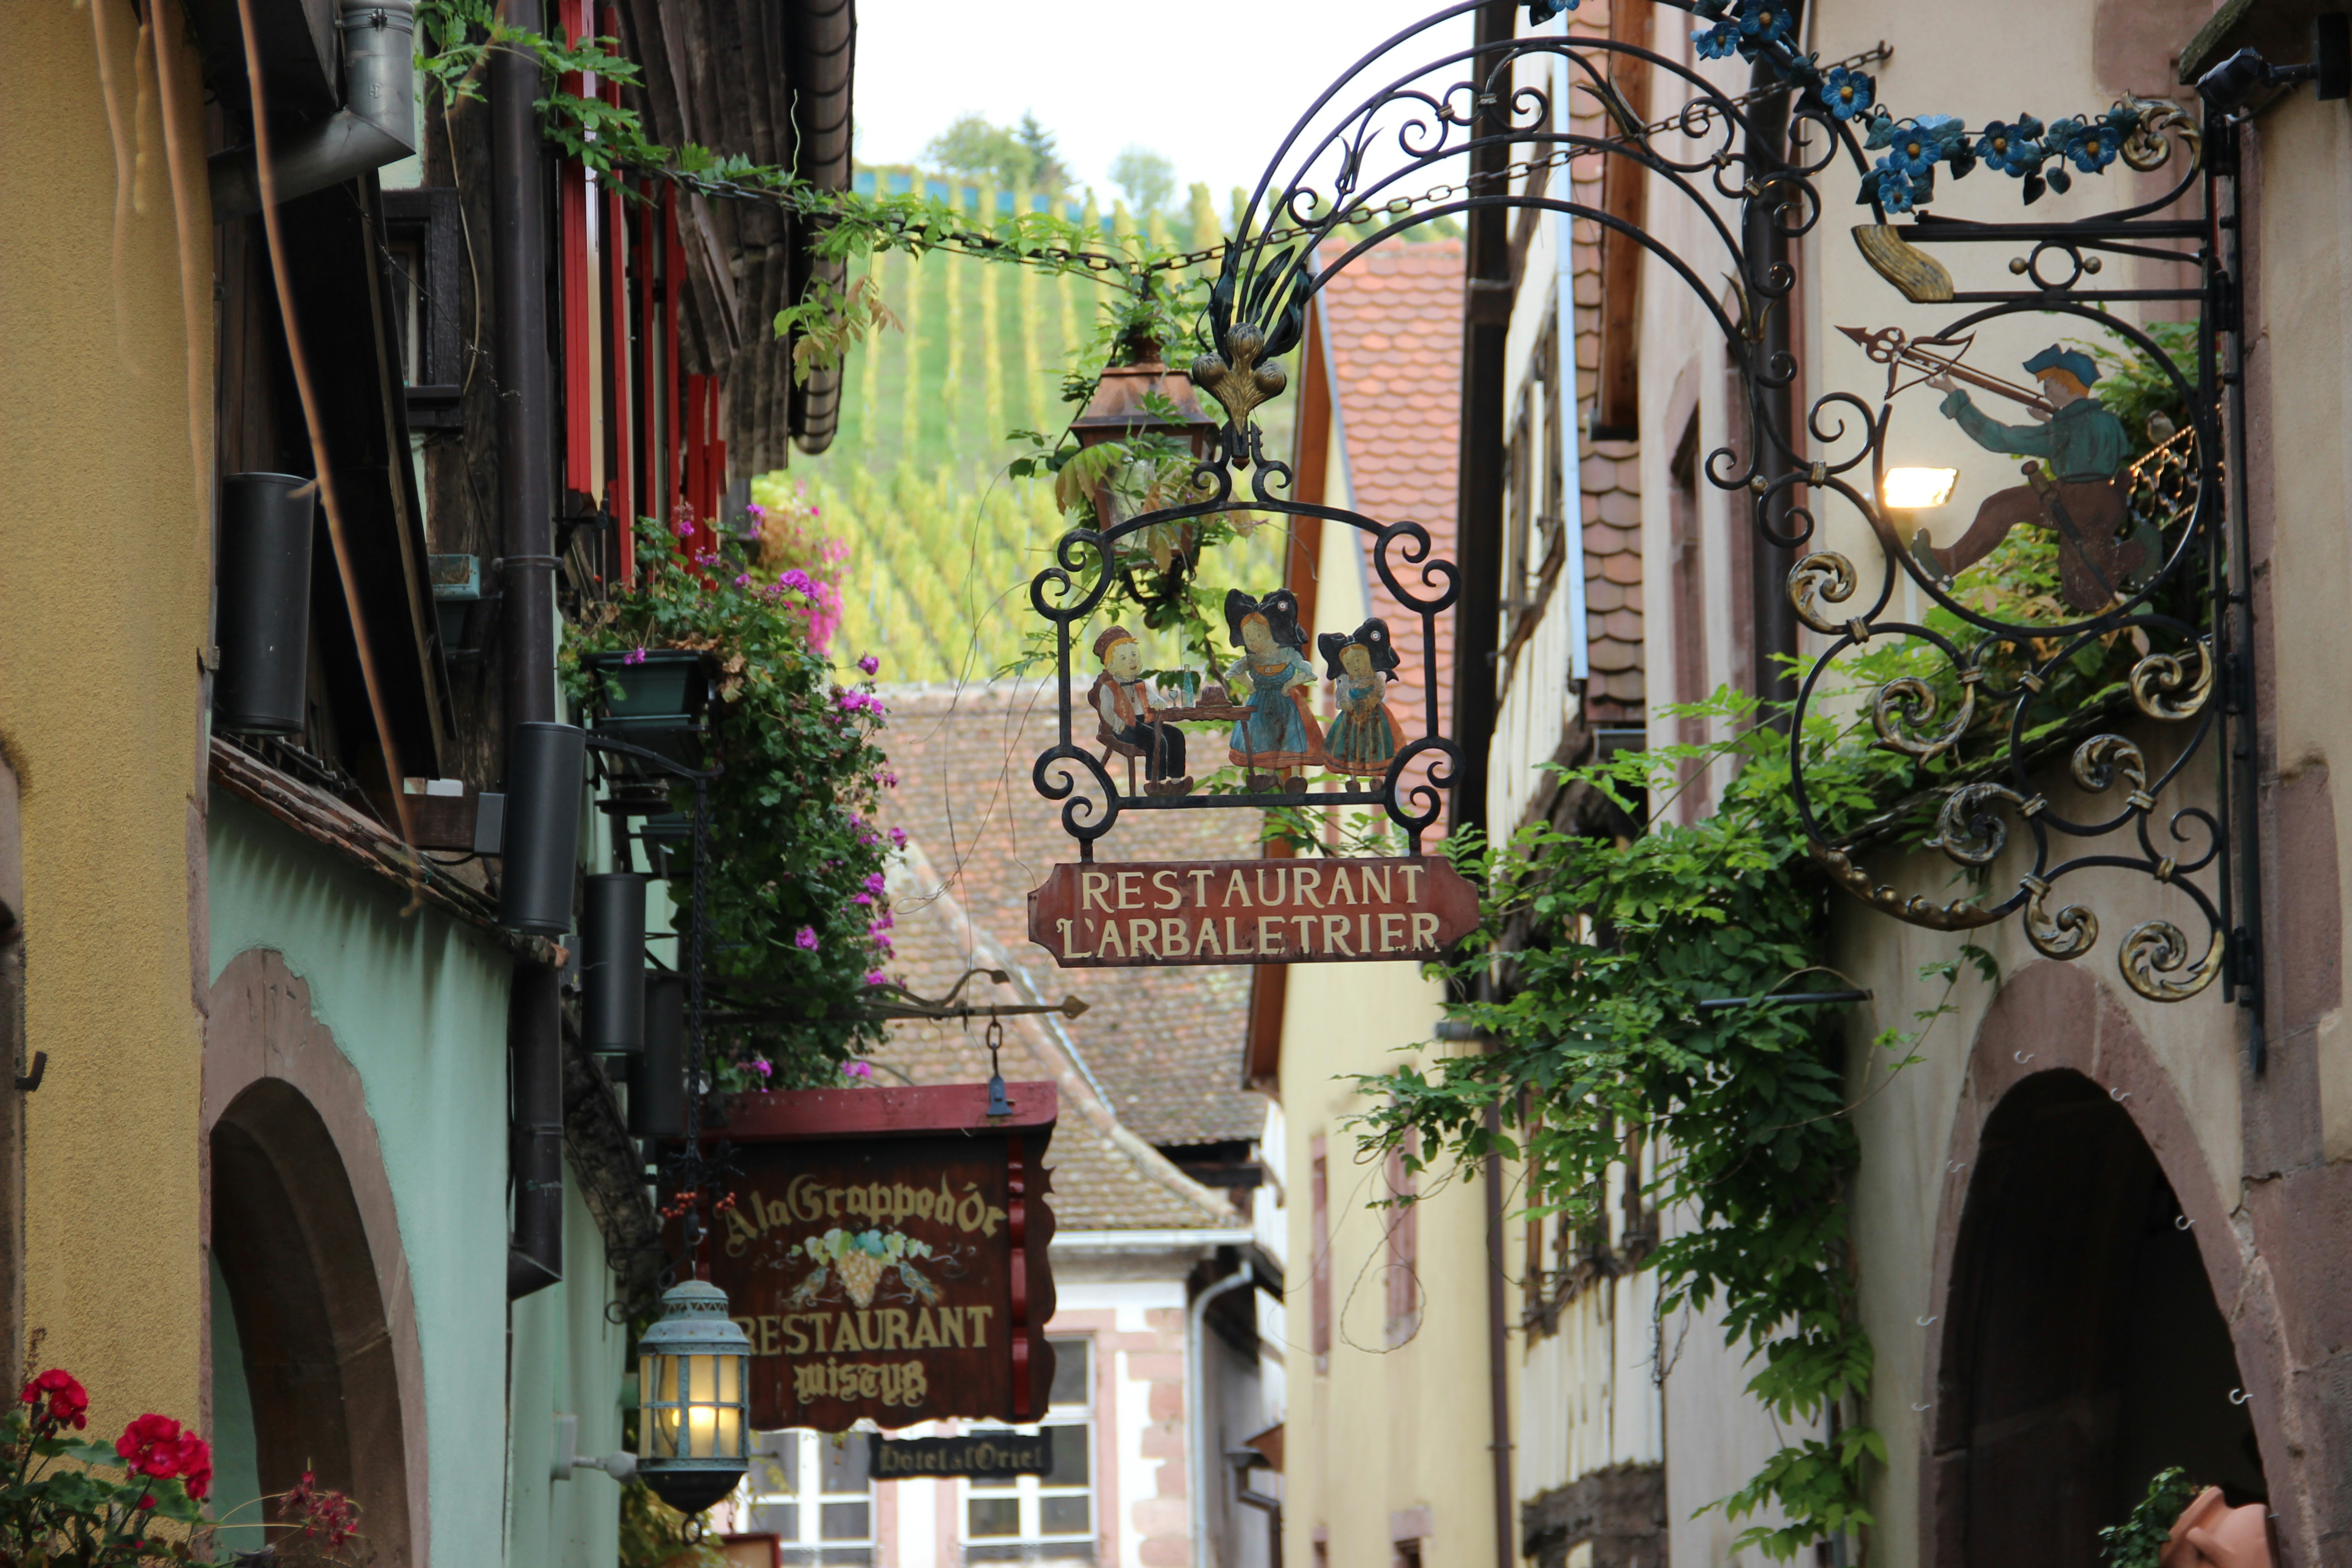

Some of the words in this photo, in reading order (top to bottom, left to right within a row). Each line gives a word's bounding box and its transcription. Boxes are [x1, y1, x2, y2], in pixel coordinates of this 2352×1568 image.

[1081, 865, 1425, 914] RESTAURANT
[1056, 912, 1441, 960] L'ARBALETRIER
[750, 1191, 792, 1231] la
[787, 1173, 935, 1225] Grappe
[729, 1306, 993, 1356] RESTAURANT
